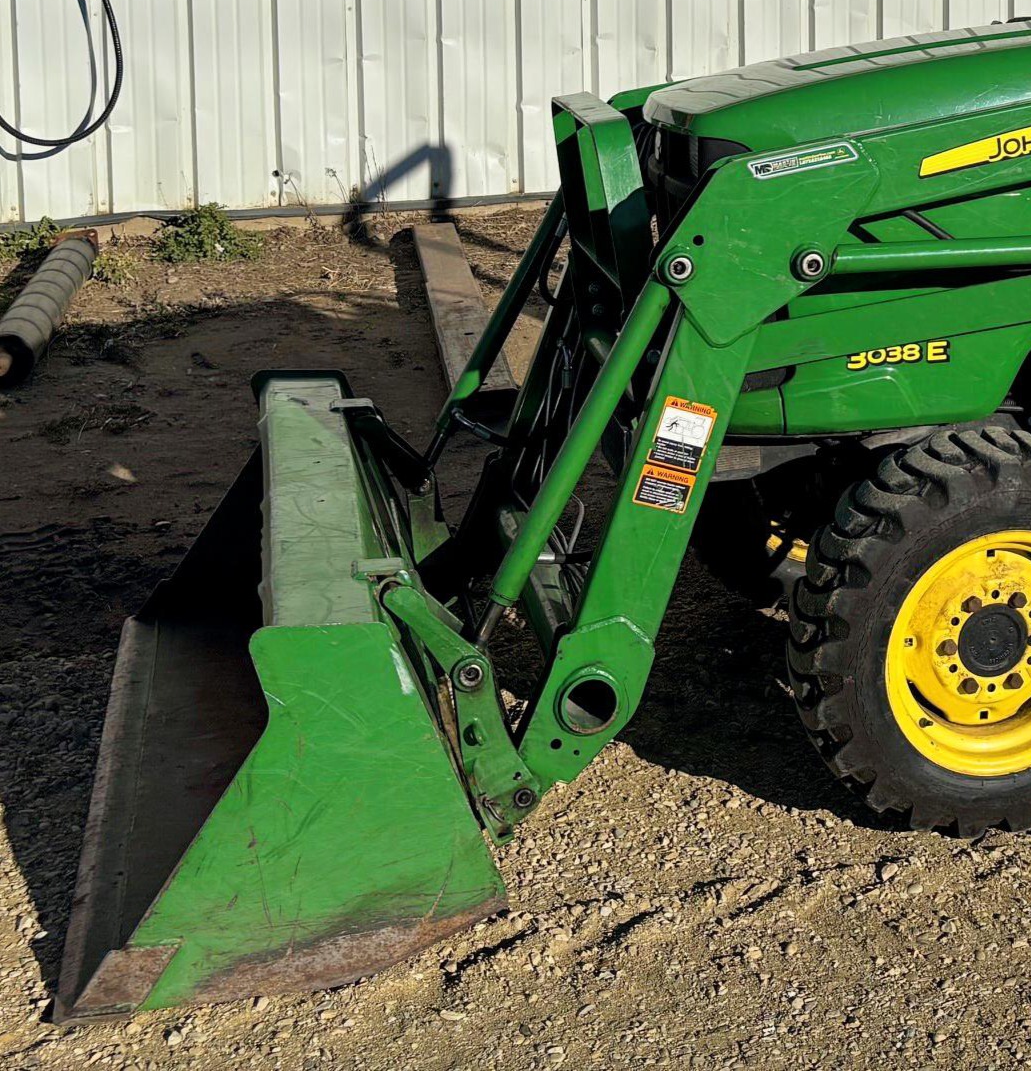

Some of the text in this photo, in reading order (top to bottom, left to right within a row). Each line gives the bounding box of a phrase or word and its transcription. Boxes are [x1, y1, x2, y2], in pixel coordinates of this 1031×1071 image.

[847, 340, 948, 370] 3038 E
[679, 402, 712, 416] WARNING
[656, 470, 689, 484] WARNING
